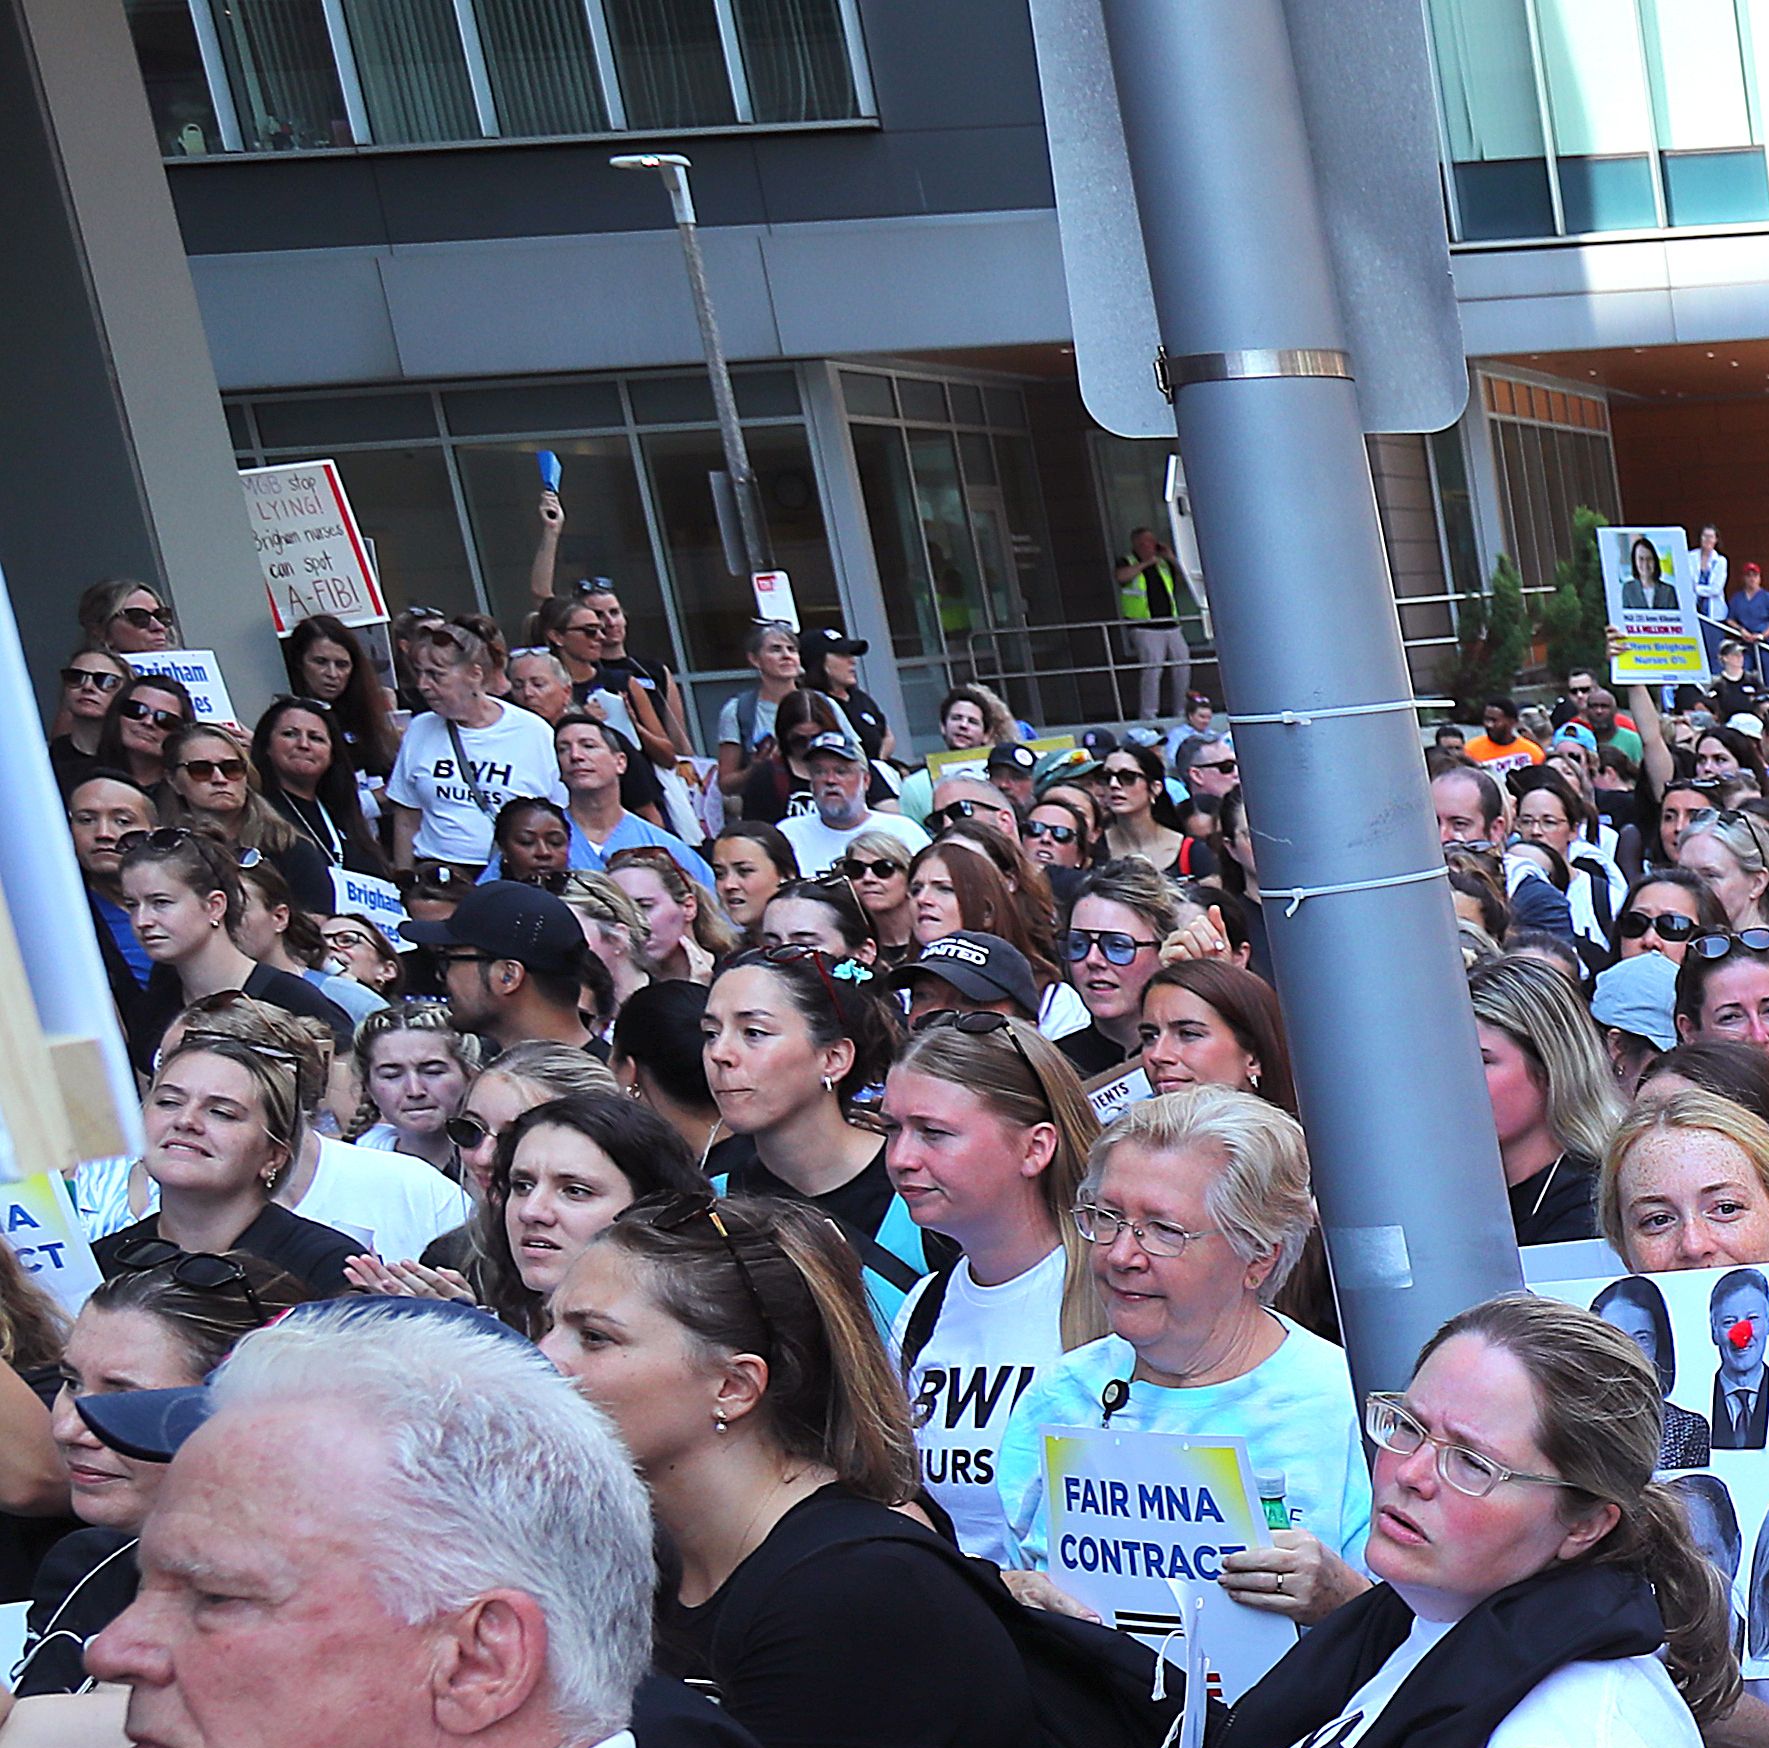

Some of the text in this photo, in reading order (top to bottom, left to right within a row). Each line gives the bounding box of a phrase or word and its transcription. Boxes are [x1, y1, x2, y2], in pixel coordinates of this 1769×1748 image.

[288, 472, 316, 492] stop
[256, 494, 324, 521] LYING!
[304, 523, 345, 543] nurses
[269, 550, 334, 580] can spot
[288, 576, 363, 616] A-FIB!
[1063, 1476, 1226, 1524] FAIR MNA
